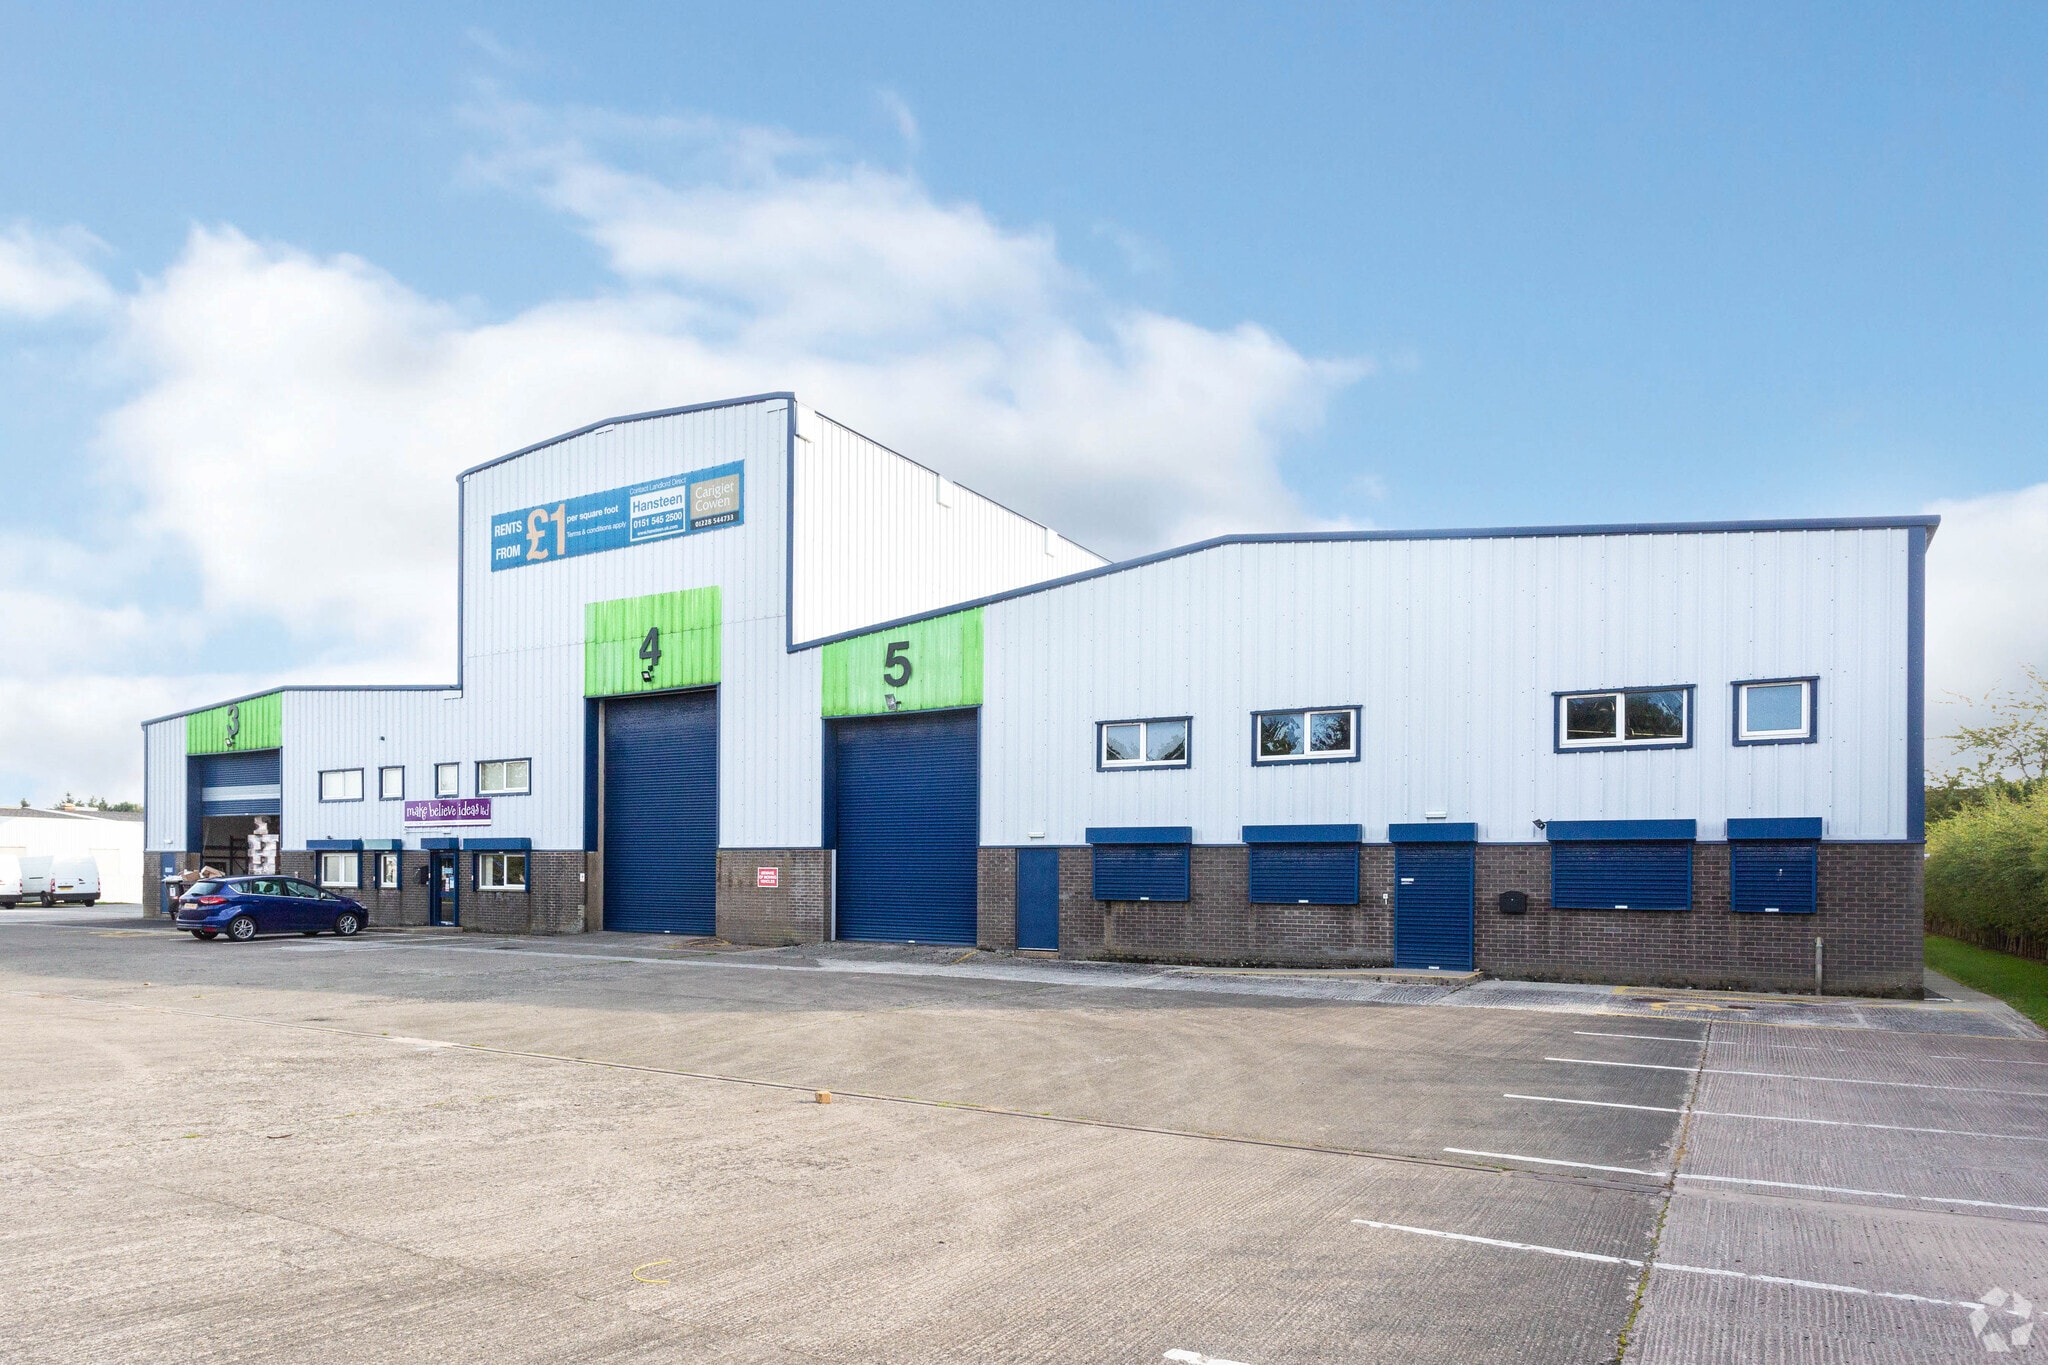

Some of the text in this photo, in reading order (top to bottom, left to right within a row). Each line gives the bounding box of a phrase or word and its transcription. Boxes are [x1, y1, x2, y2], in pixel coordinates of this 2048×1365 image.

[695, 482, 734, 499] Carigiet
[633, 494, 682, 513] Hansteen
[695, 497, 730, 512] Cowen
[566, 505, 619, 525] per square foot
[633, 512, 682, 529] 0151 545 2500
[494, 520, 523, 537] RENTS
[526, 503, 565, 561] £1
[567, 521, 627, 538] Terms & conditions apply
[495, 544, 521, 560] FROM
[639, 627, 662, 666] 4
[883, 641, 912, 688] 5
[226, 704, 239, 736] 3
[406, 803, 427, 820] make
[428, 802, 457, 817] believe
[458, 801, 479, 817] ideas
